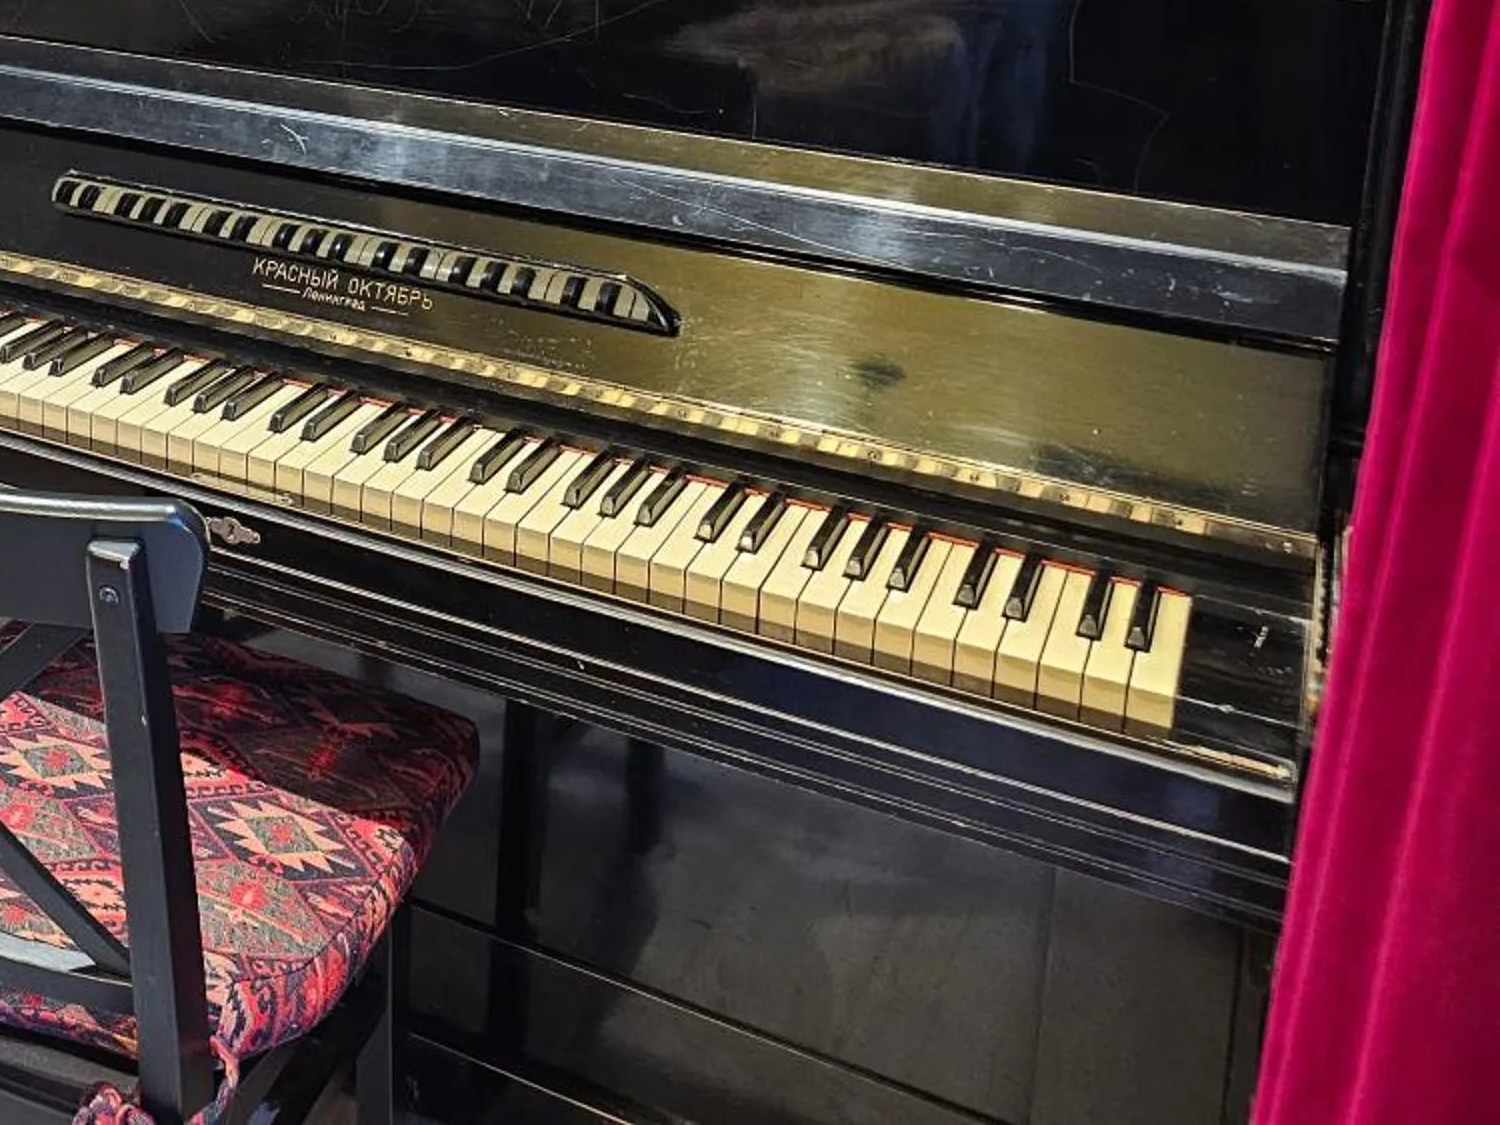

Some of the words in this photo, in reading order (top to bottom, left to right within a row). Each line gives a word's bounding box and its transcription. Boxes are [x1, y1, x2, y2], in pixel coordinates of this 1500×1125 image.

[252, 256, 339, 290] КРАСНЫЙ
[349, 277, 433, 311] ОКТЯБРЬ
[301, 286, 366, 312] Ленинград
